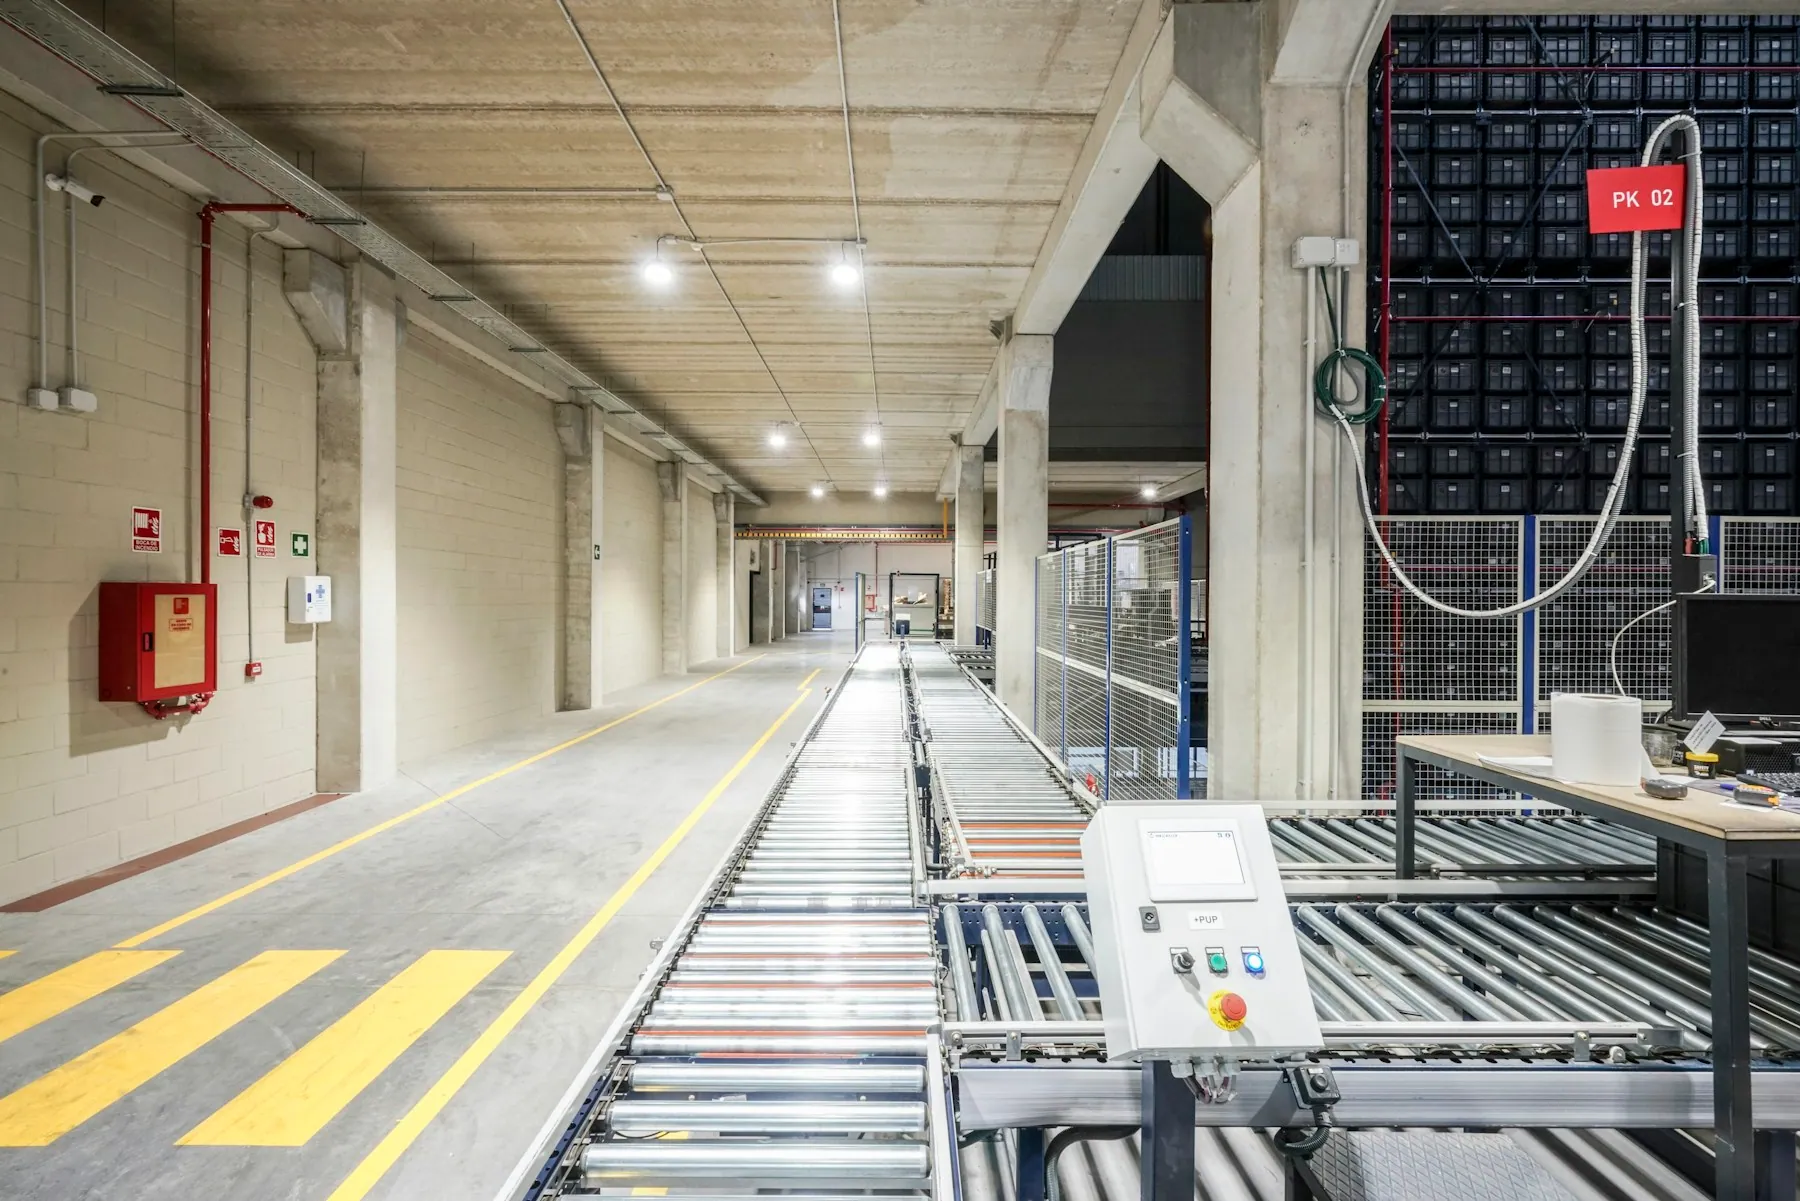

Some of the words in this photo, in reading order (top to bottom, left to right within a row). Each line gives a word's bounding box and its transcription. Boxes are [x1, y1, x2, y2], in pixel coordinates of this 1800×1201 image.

[1612, 191, 1640, 209] PK
[1651, 188, 1674, 207] 02
[1194, 915, 1218, 924] +PUP
